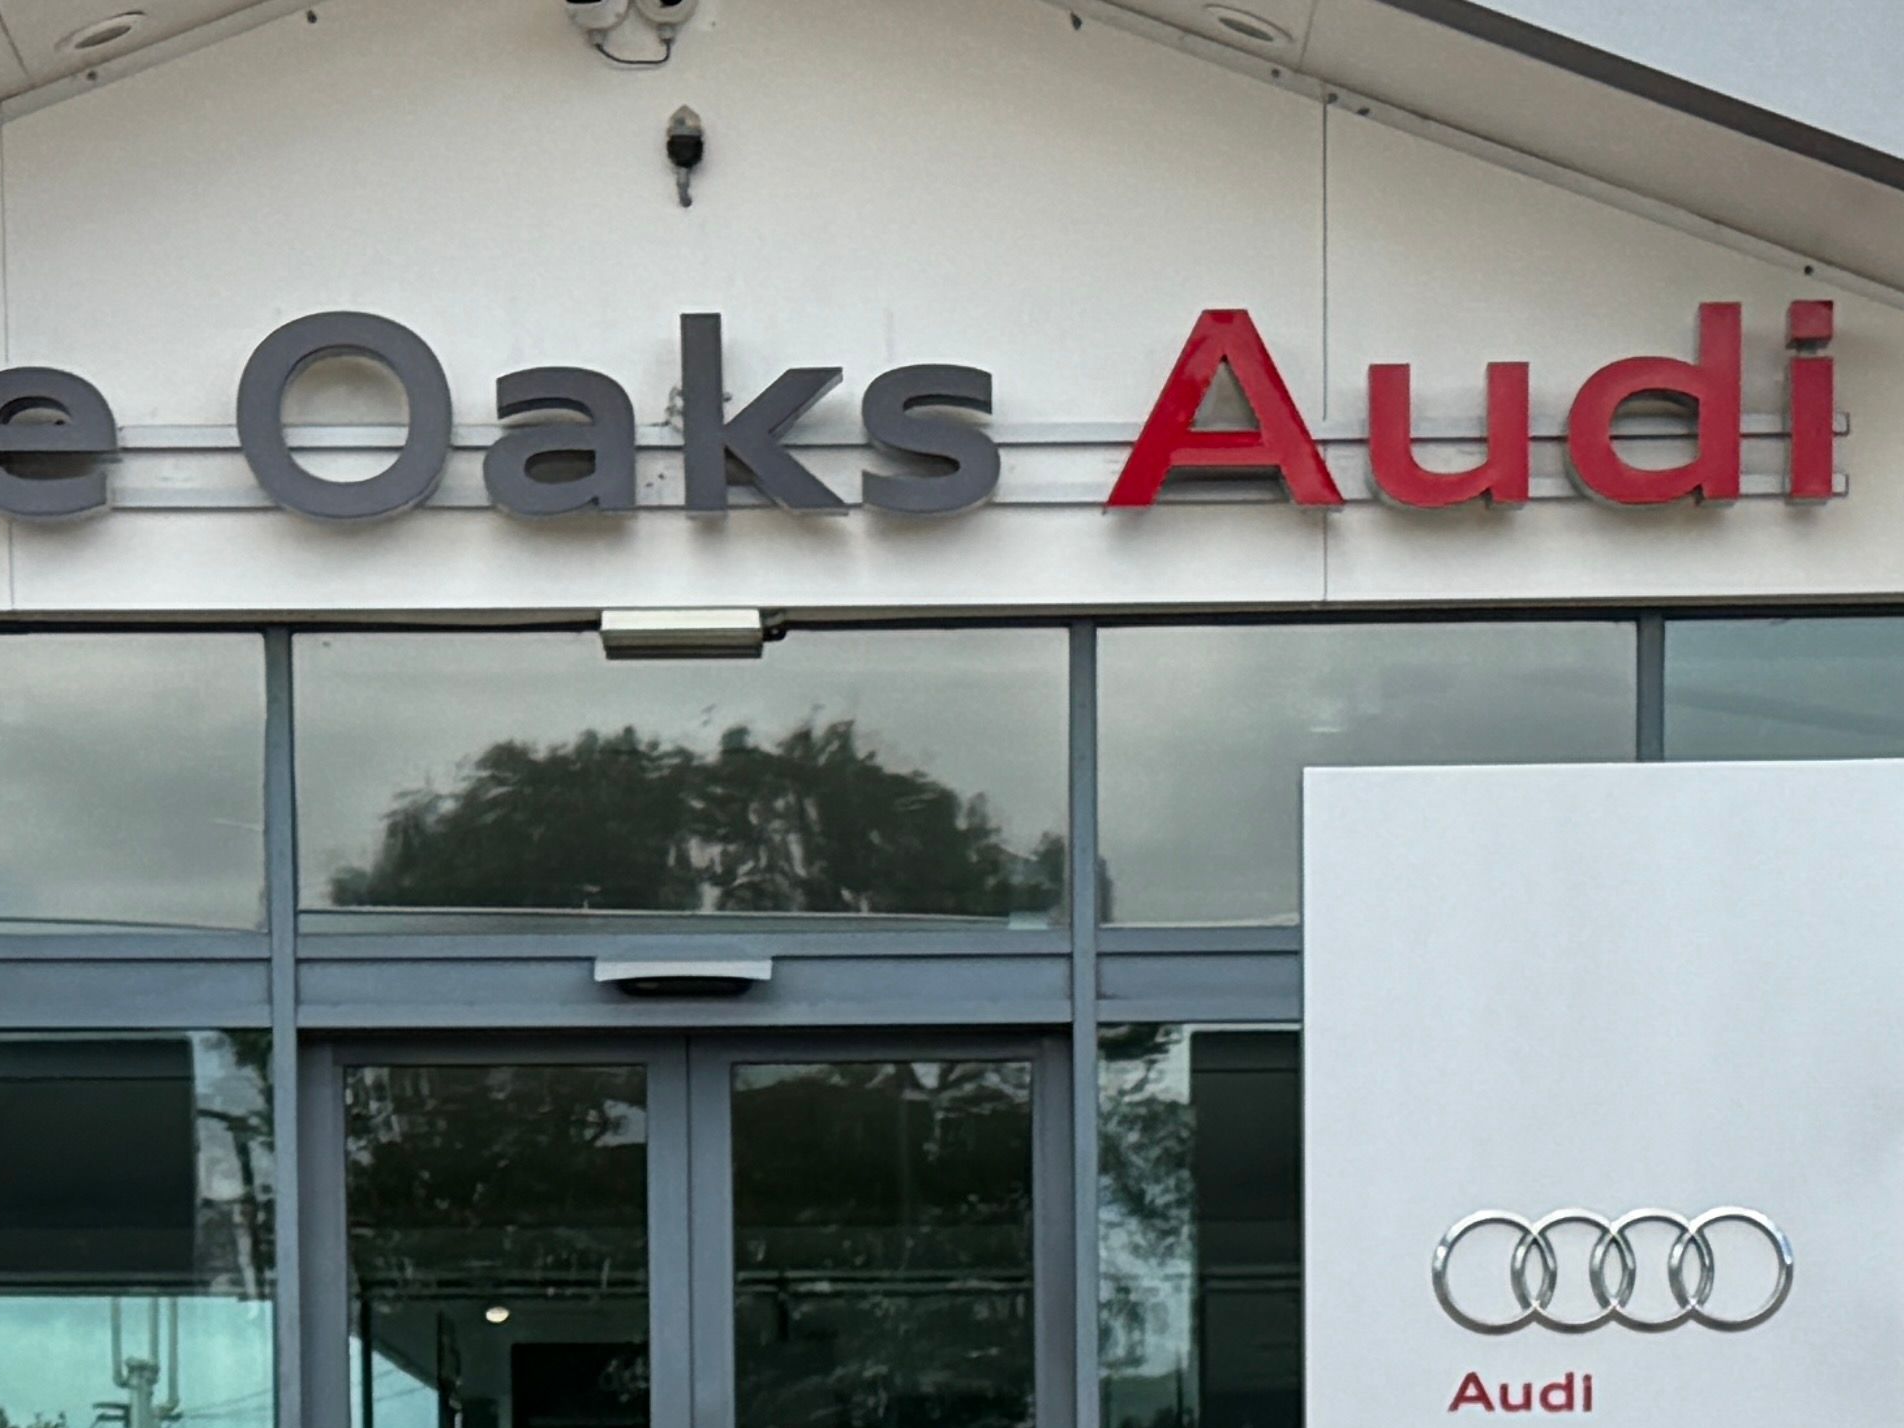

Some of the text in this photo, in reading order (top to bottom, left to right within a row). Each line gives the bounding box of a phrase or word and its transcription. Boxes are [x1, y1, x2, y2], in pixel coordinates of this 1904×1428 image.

[237, 310, 1001, 519] Oaks
[1104, 299, 1834, 511] Audi
[1448, 1372, 1594, 1413] Audi
